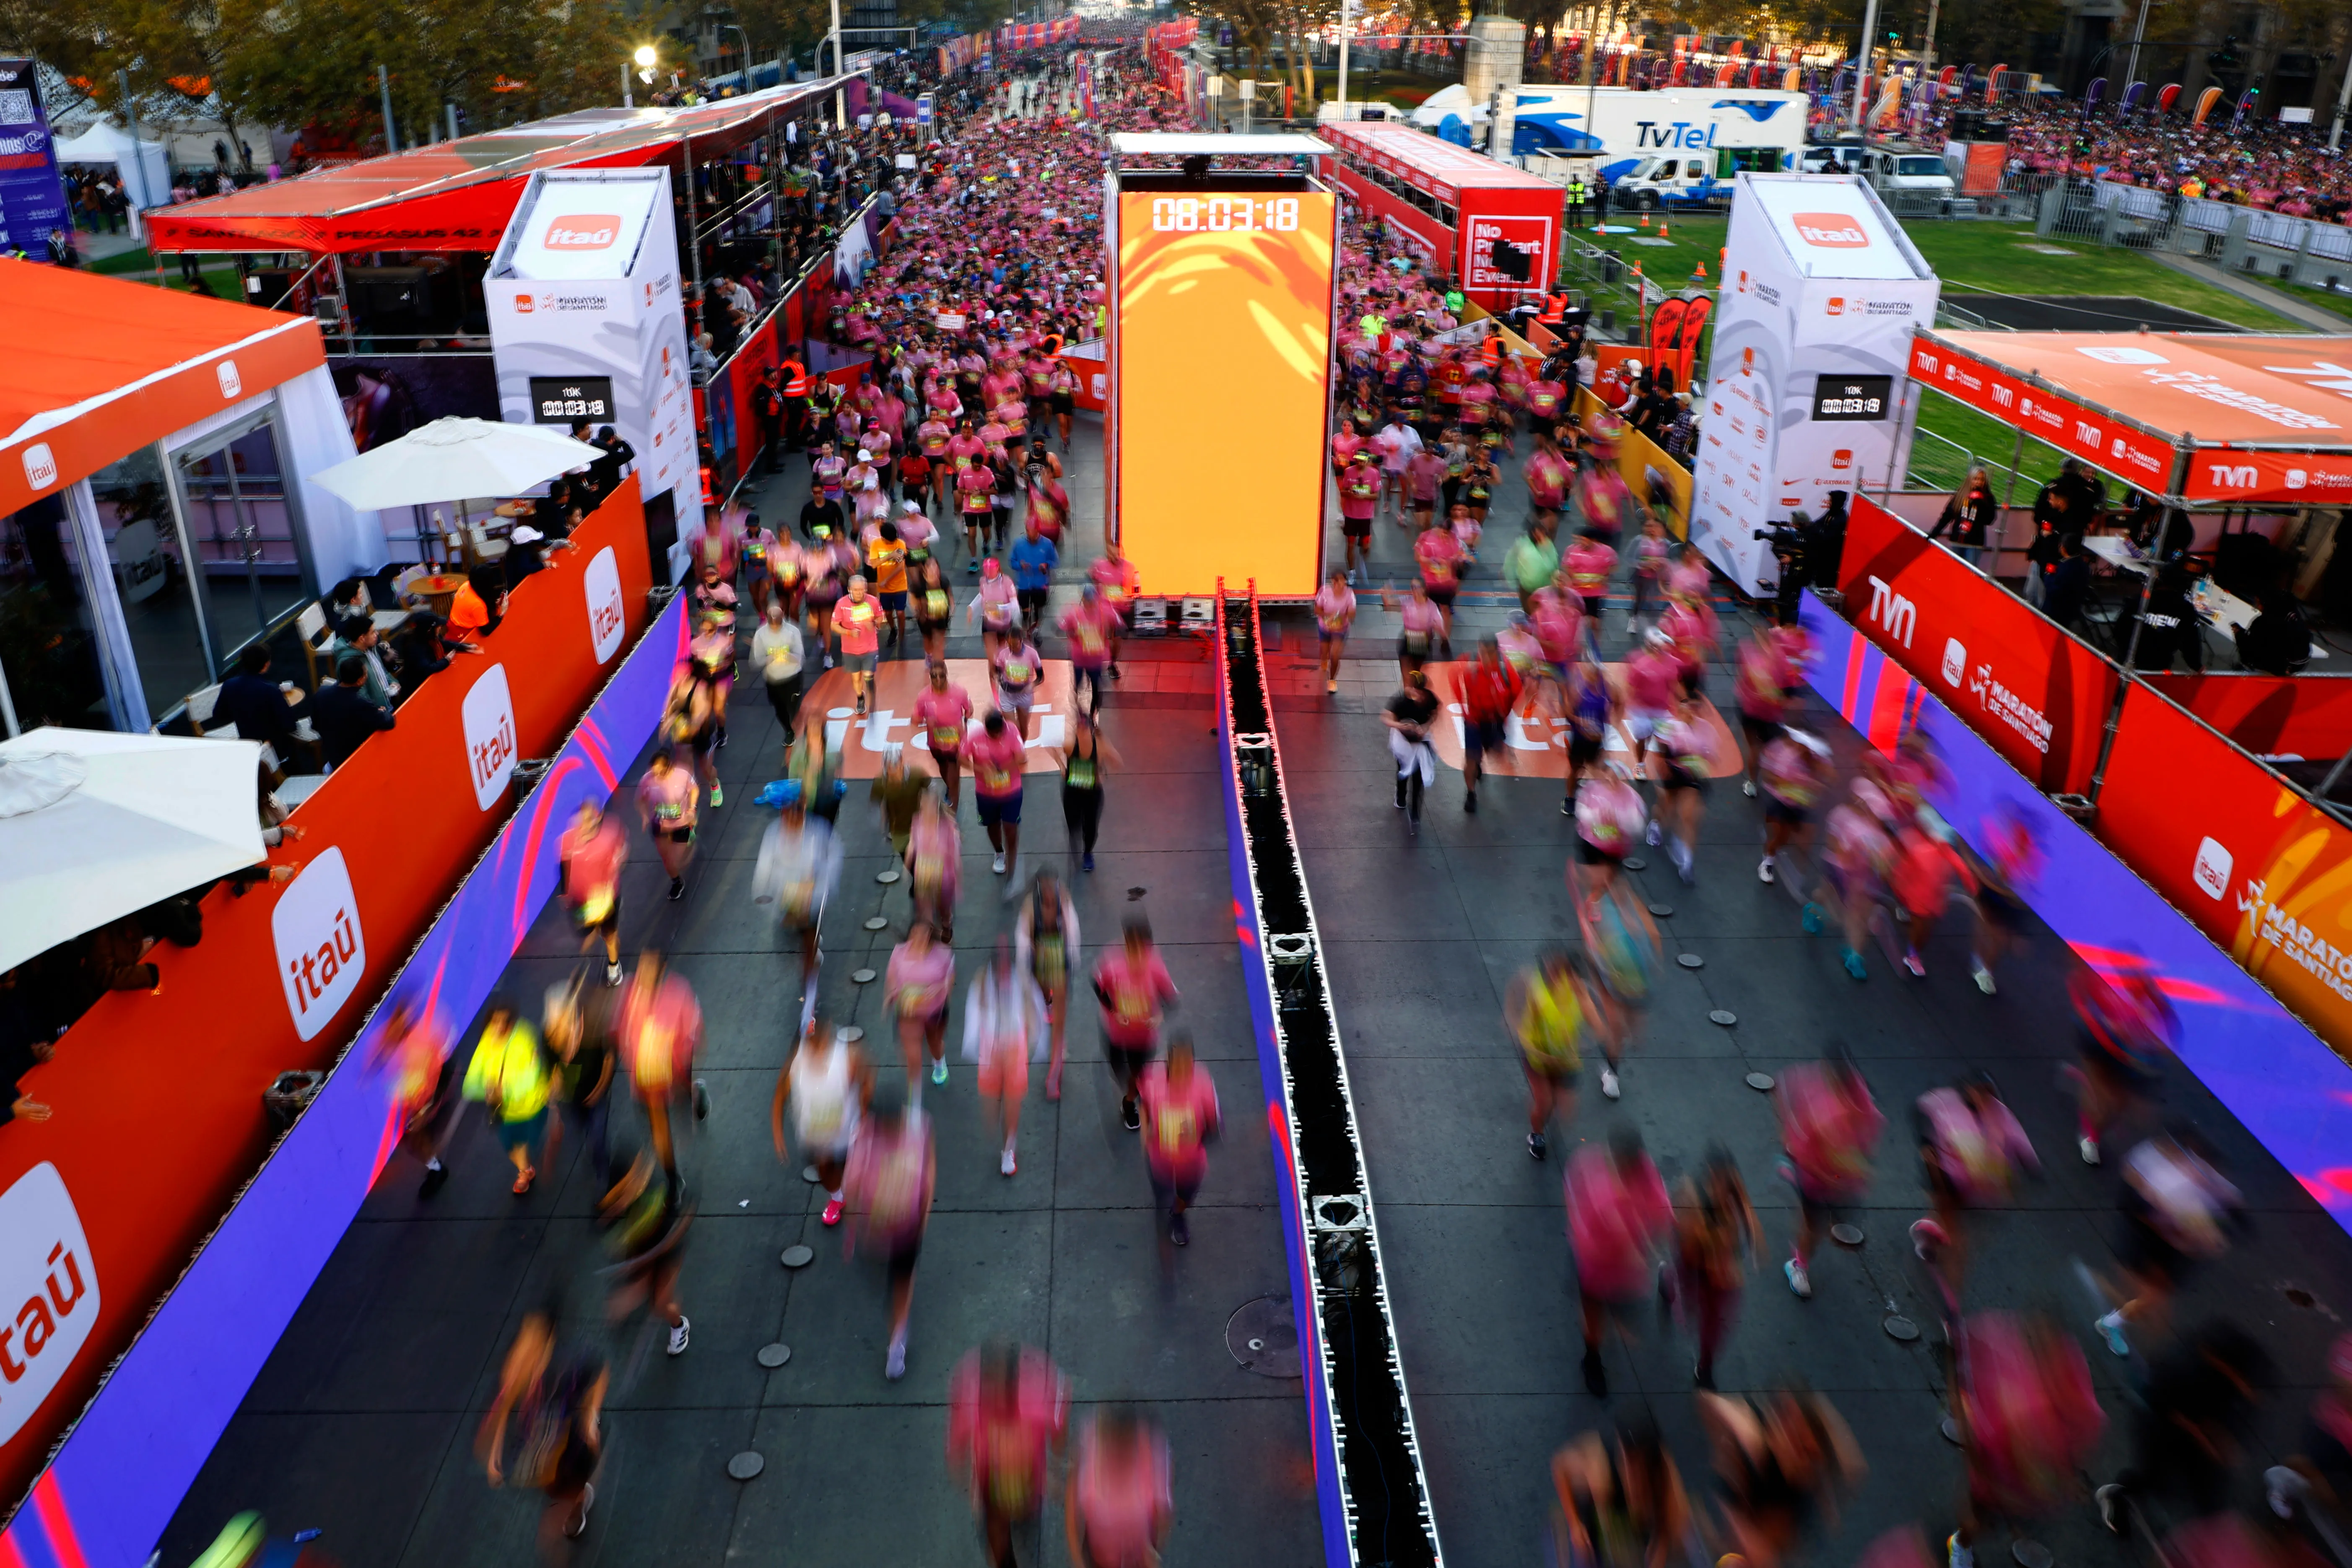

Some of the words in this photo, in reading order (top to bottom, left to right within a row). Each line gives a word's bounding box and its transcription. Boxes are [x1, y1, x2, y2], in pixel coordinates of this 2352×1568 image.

[1634, 121, 1719, 148] TvTel
[1153, 198, 1298, 231] 08:03:18
[186, 227, 306, 239] SANTIAGO
[334, 228, 447, 241] PEGASUS
[452, 228, 484, 239] 42
[548, 228, 612, 244] itaú
[1475, 223, 1502, 238] No
[1800, 226, 1865, 243] itaú
[557, 294, 607, 305] MARATÓN
[1868, 301, 1913, 310] MARATÓN
[562, 387, 582, 397] 10K
[1845, 386, 1863, 395] 10K
[593, 588, 621, 645] itaú
[1991, 680, 2053, 741] MARATÓN
[2002, 712, 2048, 753] SANTIAGO
[473, 714, 512, 789] itaú
[2260, 922, 2284, 949] DE
[288, 906, 357, 1015] itaú
[0, 1239, 86, 1403] taú
